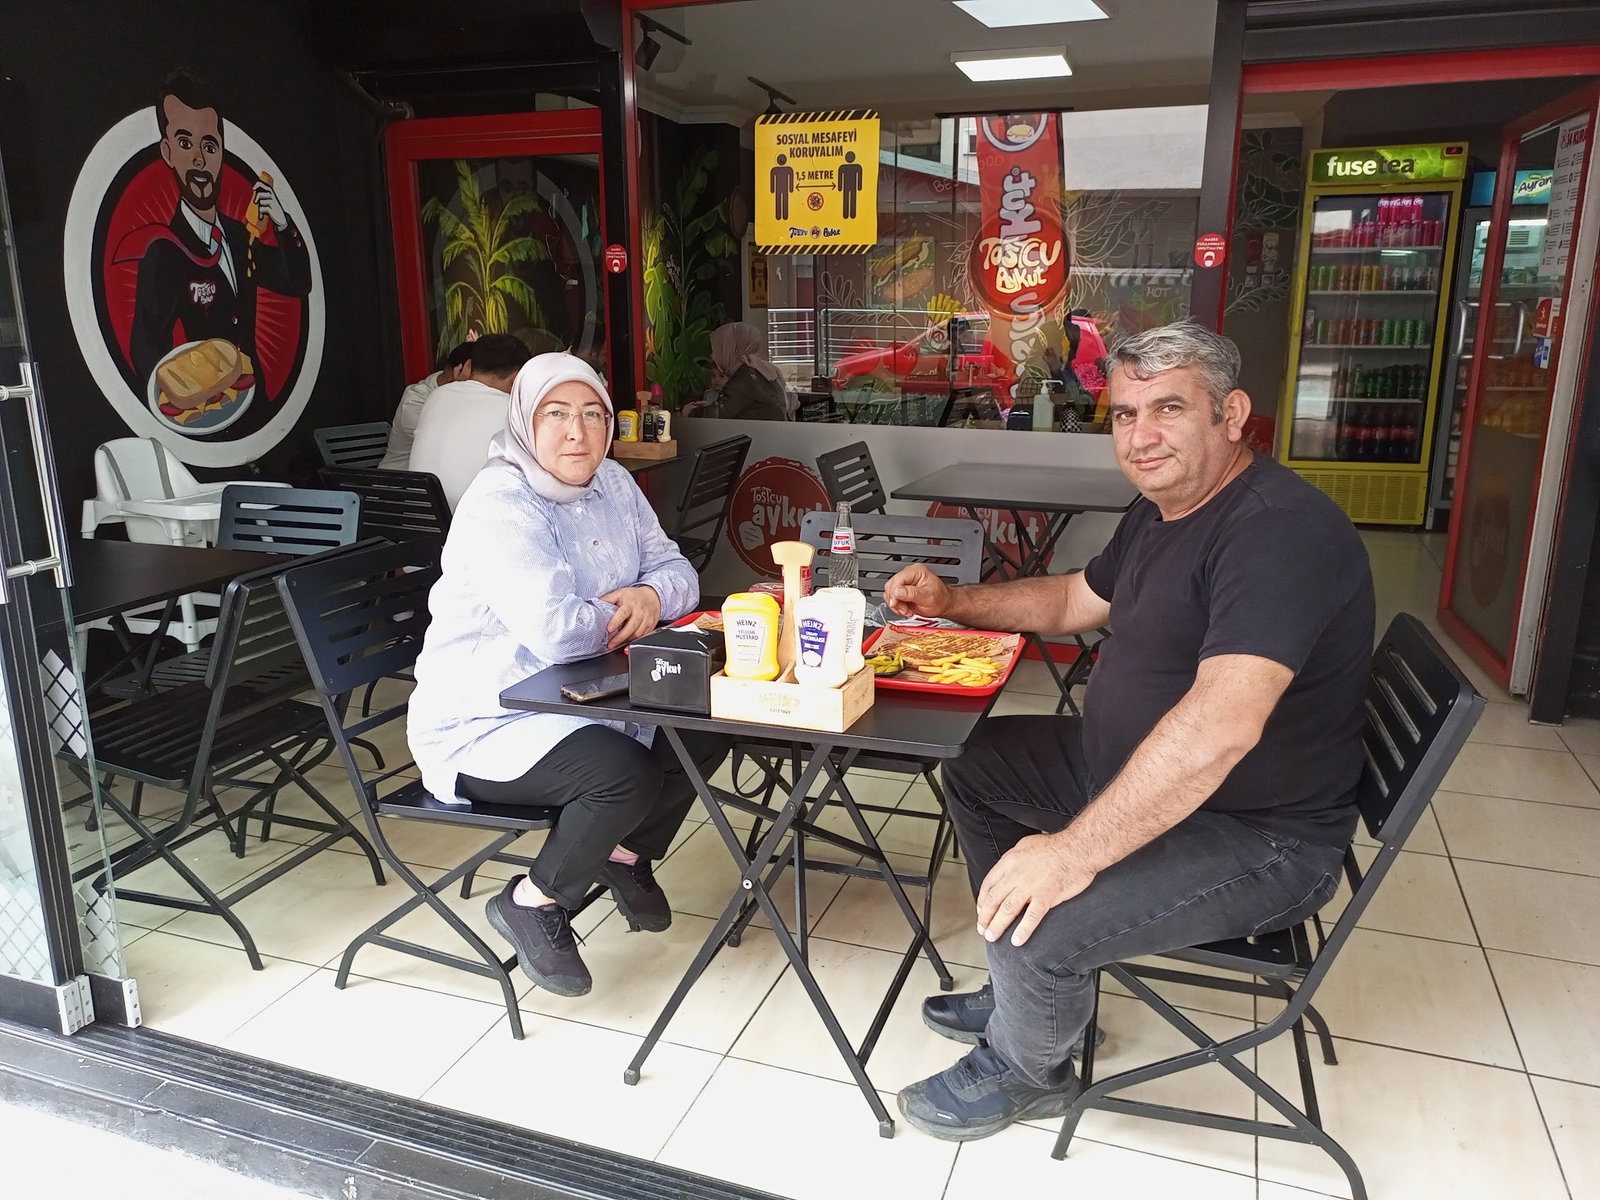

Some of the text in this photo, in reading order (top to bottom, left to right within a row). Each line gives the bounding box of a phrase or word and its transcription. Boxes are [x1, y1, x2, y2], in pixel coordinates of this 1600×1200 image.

[776, 128, 857, 145] SOSYAL MESAFEYİ
[789, 145, 843, 158] KORUYALIM
[796, 170, 834, 181] 1,5 METRE
[736, 619, 758, 628] HEINZ
[802, 620, 823, 630] HEINZ
